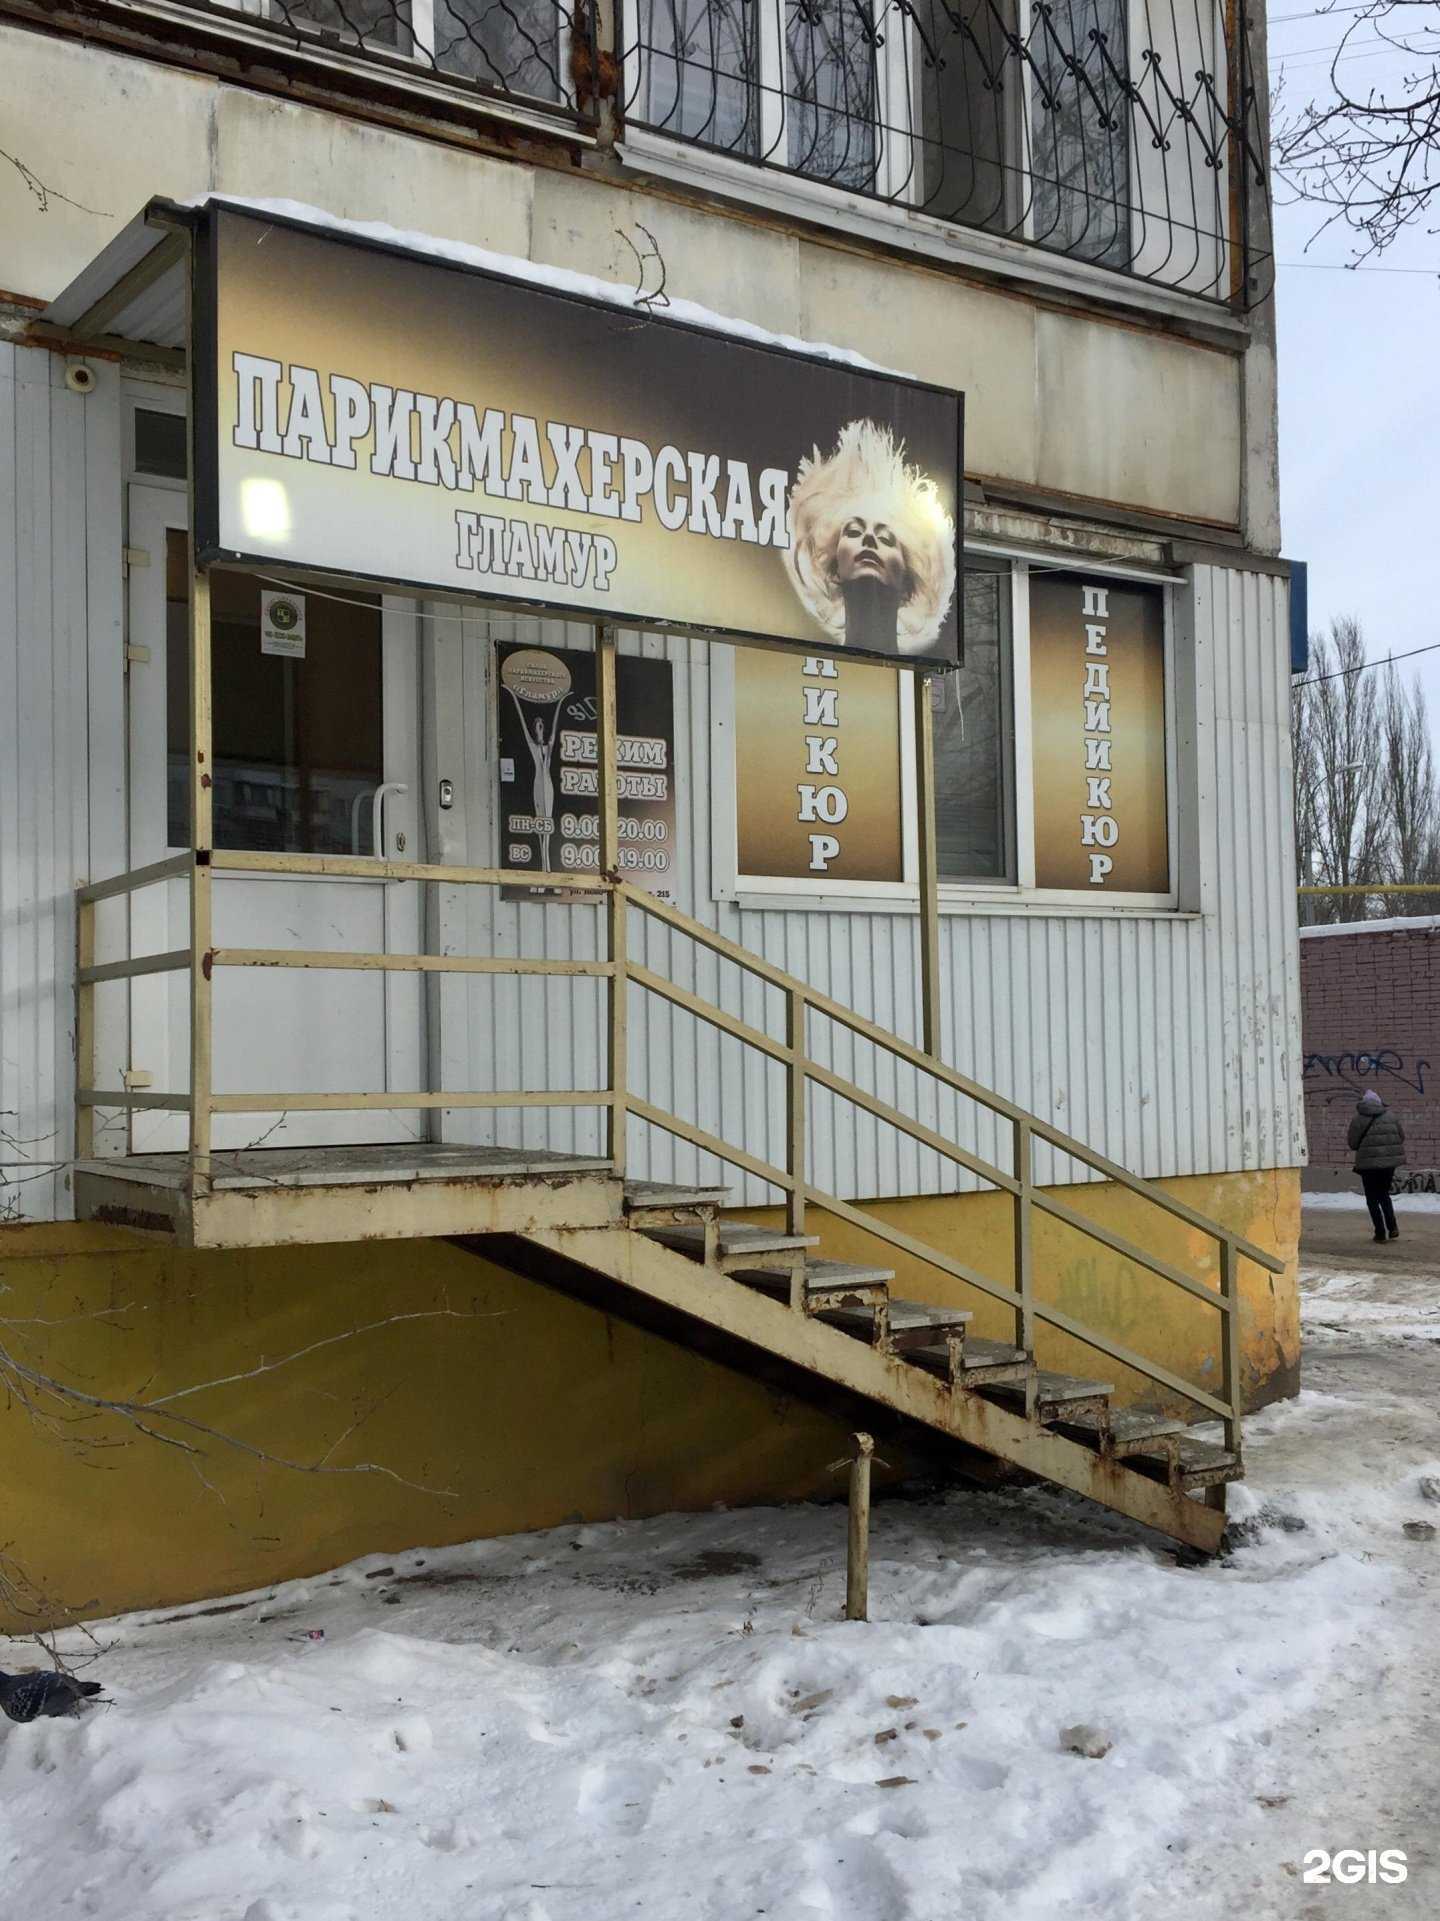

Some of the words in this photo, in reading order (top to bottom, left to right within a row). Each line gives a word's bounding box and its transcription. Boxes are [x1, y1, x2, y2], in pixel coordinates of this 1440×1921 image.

[233, 351, 790, 549] ПАРИКМАХЕРСКАЯ
[455, 510, 617, 591] ГЛАМУР
[563, 770, 666, 798] РАОТЫ
[510, 815, 553, 833] ПН-СБ
[511, 846, 530, 861] ВС
